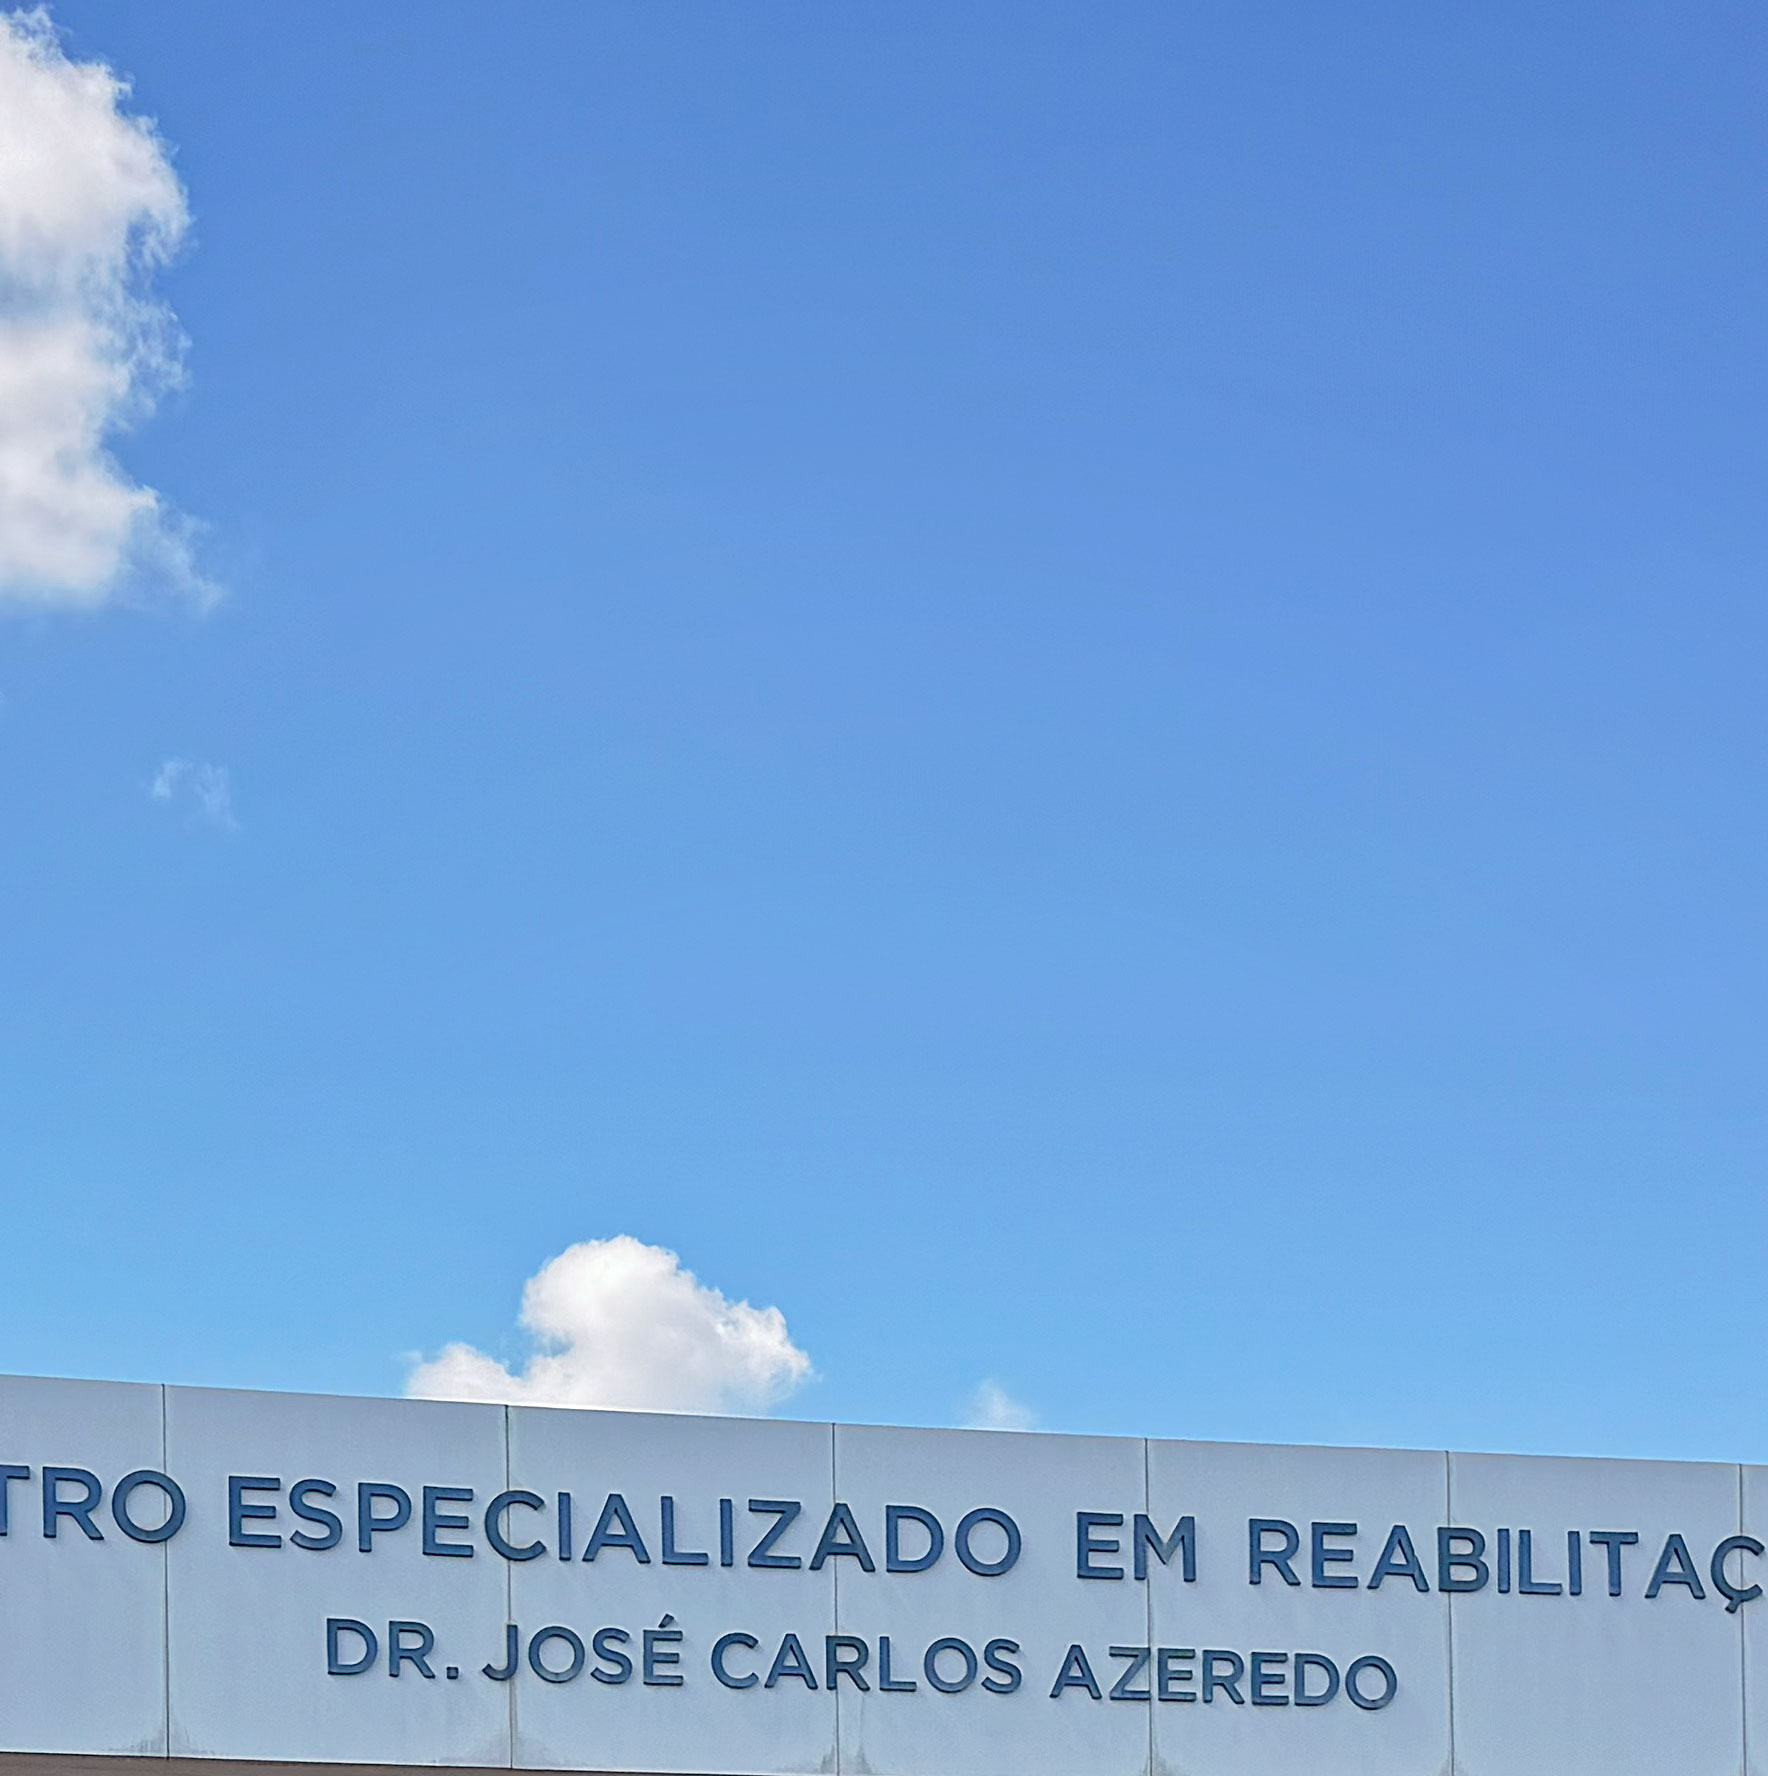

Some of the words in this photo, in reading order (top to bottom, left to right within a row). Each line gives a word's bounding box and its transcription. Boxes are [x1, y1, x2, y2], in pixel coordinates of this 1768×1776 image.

[228, 1473, 1023, 1578] ESPECIALIZADO
[1075, 1511, 1198, 1584] EM
[325, 1617, 461, 1681] DR.
[481, 1613, 685, 1688] JOSÉ
[709, 1631, 1024, 1698] CARLOS
[1048, 1644, 1400, 1712] AZEREDO
